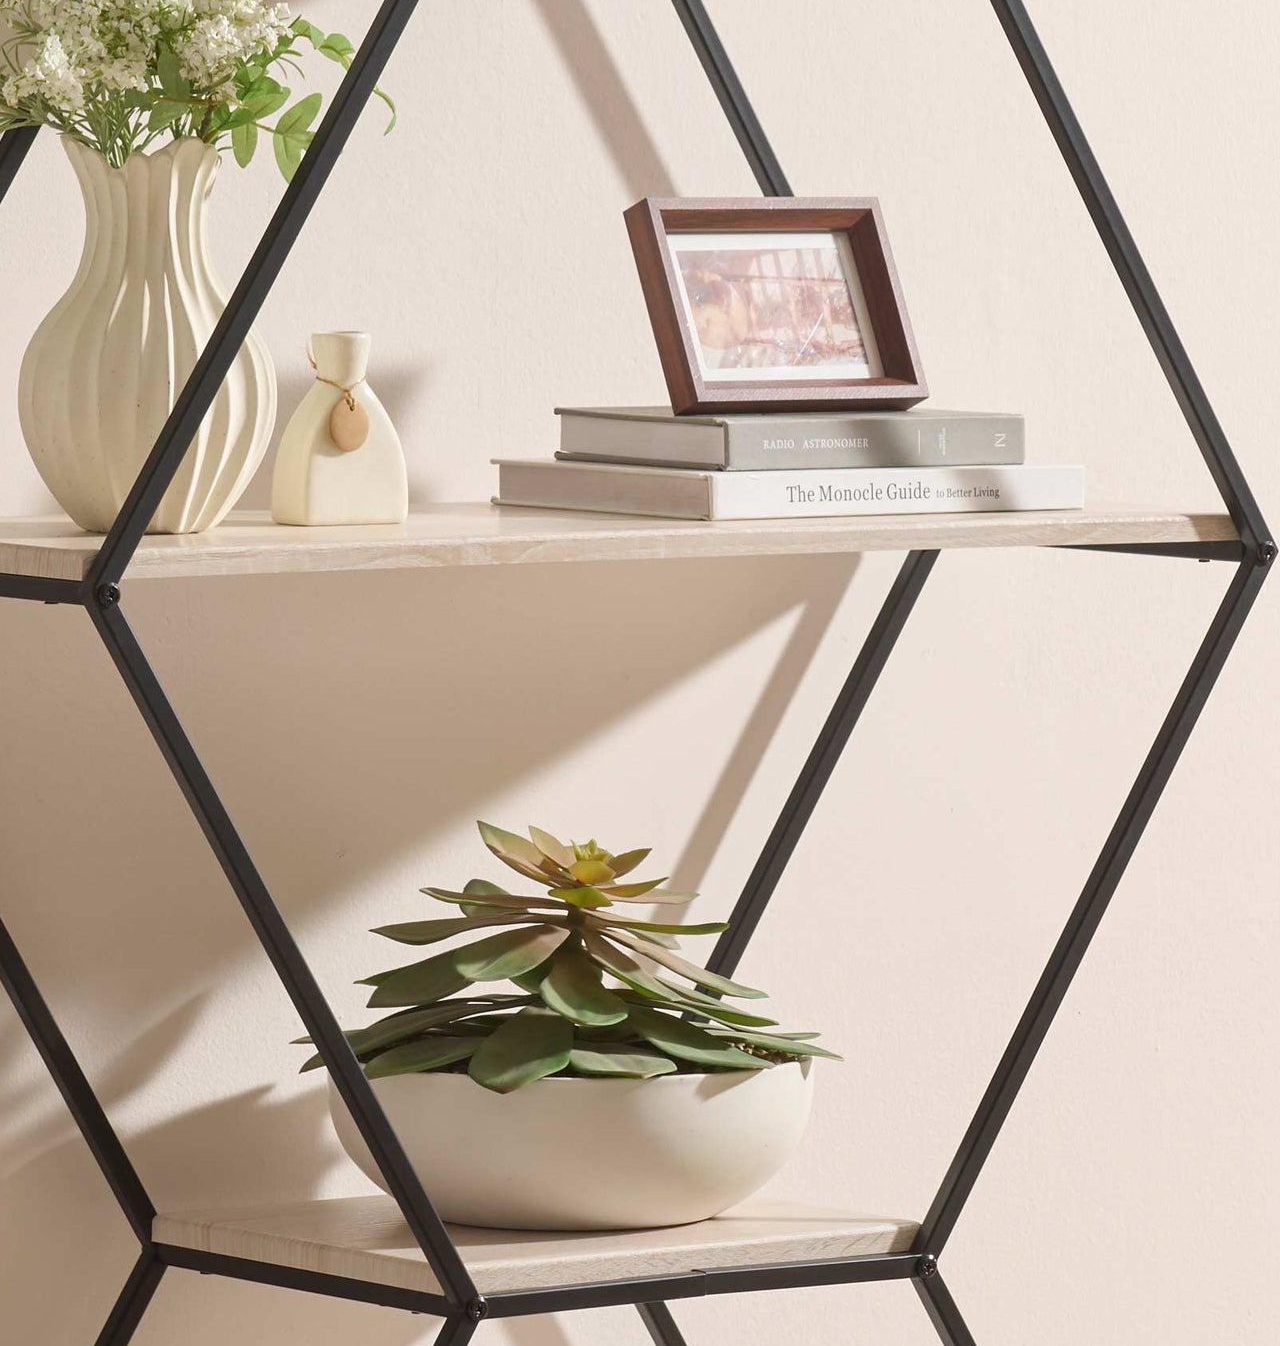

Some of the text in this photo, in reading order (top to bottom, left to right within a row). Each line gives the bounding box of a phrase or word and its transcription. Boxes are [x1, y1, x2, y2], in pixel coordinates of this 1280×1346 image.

[763, 437, 869, 450] RADIO ASTRONOMER
[786, 481, 1000, 503] The Monocle Guide to Better Living
